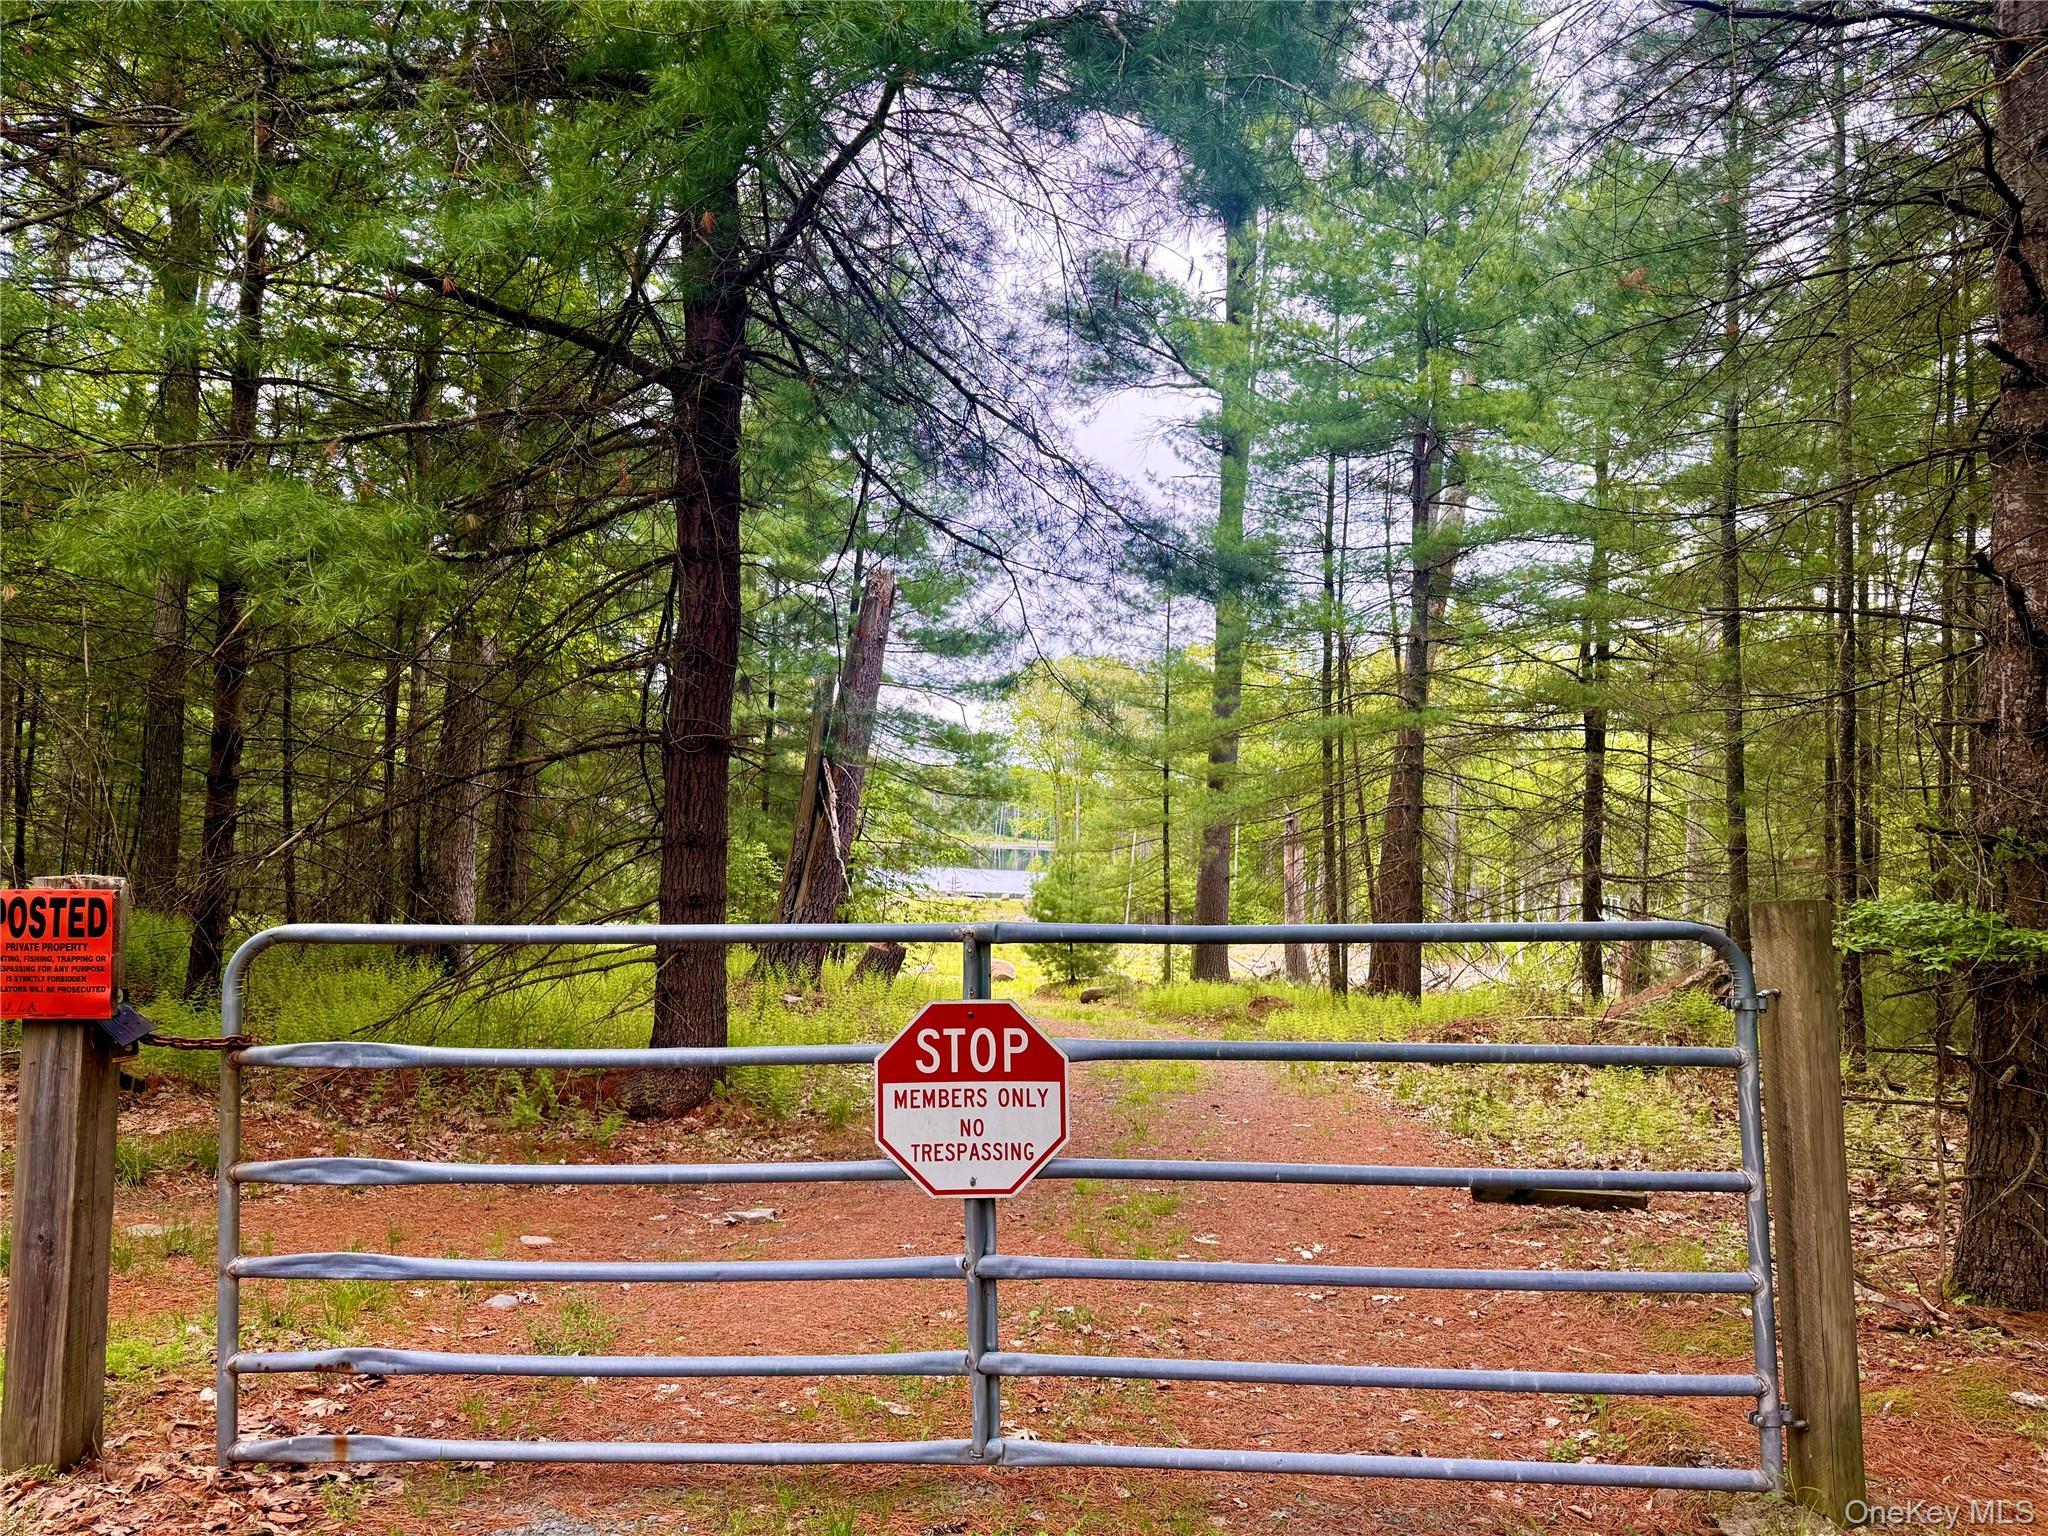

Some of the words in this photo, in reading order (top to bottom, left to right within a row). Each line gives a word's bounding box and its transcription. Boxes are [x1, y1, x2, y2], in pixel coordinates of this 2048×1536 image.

[6, 943, 39, 952] PRIVATE
[42, 943, 88, 952] PROPERTY
[57, 955, 94, 963] TRAPPING
[96, 955, 106, 963] OR
[38, 965, 52, 973] FOR
[54, 965, 69, 973] ANY
[71, 965, 106, 973] PURPOSE
[7, 975, 13, 983] IS
[14, 975, 45, 983] STRICTLY
[47, 975, 87, 983] FORBIDDEN
[29, 985, 44, 993] WILL
[46, 985, 55, 993] BE
[57, 985, 106, 993] PROSECUTED
[915, 1027, 1029, 1074] STOP
[894, 1088, 988, 1109] MEMBERS
[998, 1088, 1049, 1108] ONLY
[960, 1118, 984, 1137] NO
[911, 1142, 1035, 1162] TRESPASSING
